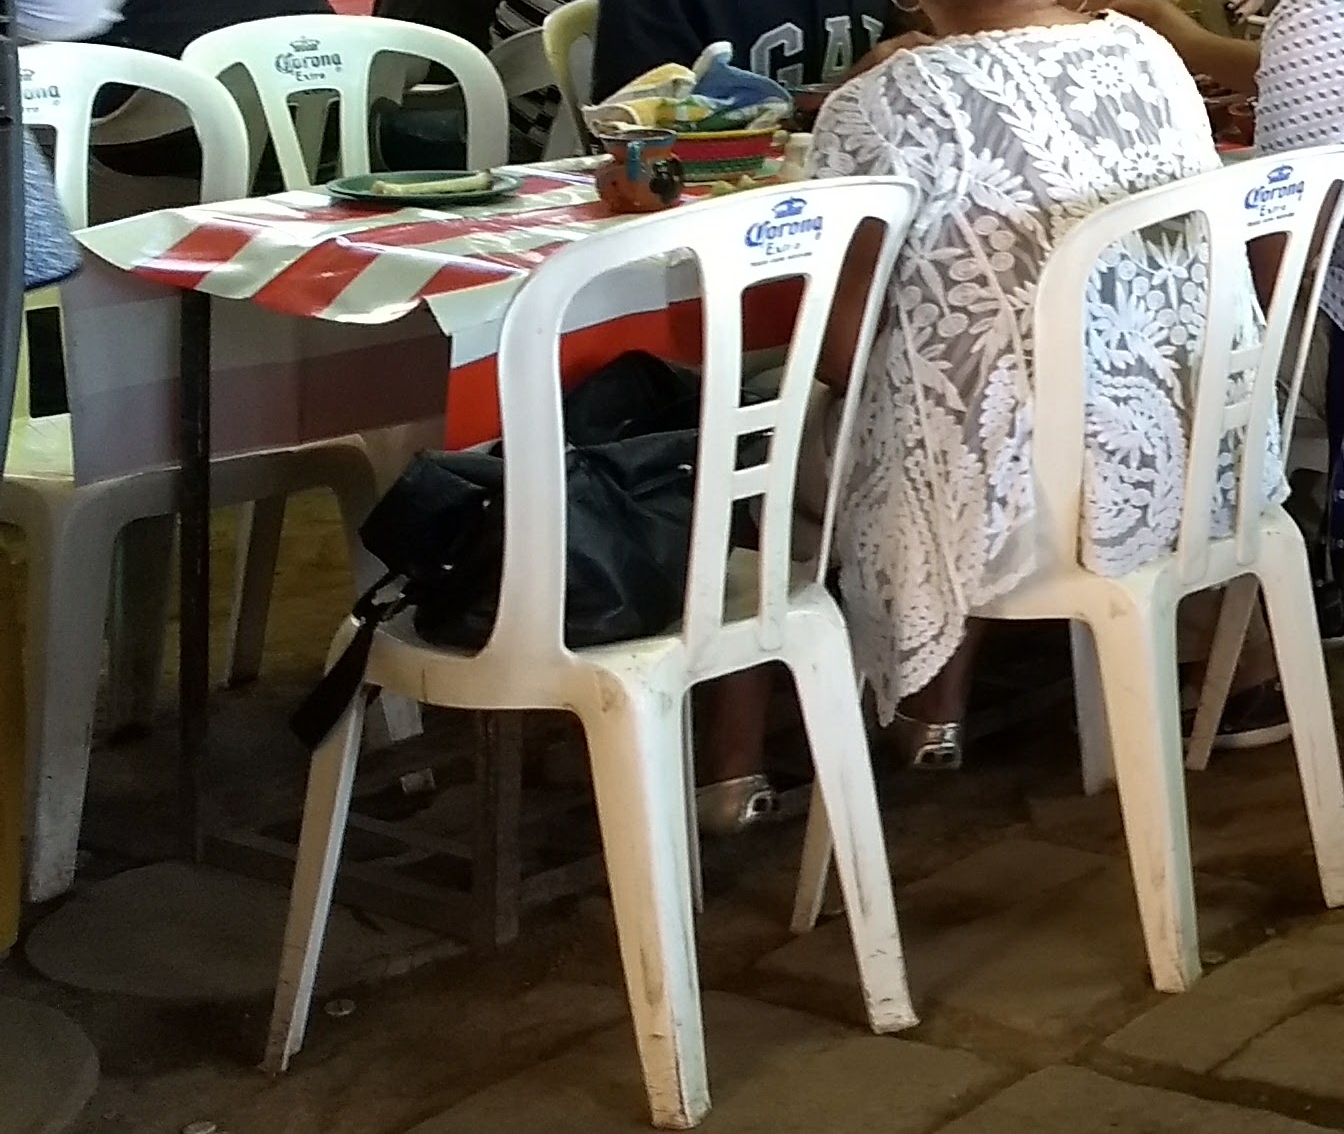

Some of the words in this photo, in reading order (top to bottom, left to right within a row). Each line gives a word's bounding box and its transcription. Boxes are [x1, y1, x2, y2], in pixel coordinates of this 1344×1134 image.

[275, 53, 342, 74] Corona
[1244, 180, 1305, 209] Corona
[744, 216, 823, 247] Corona
